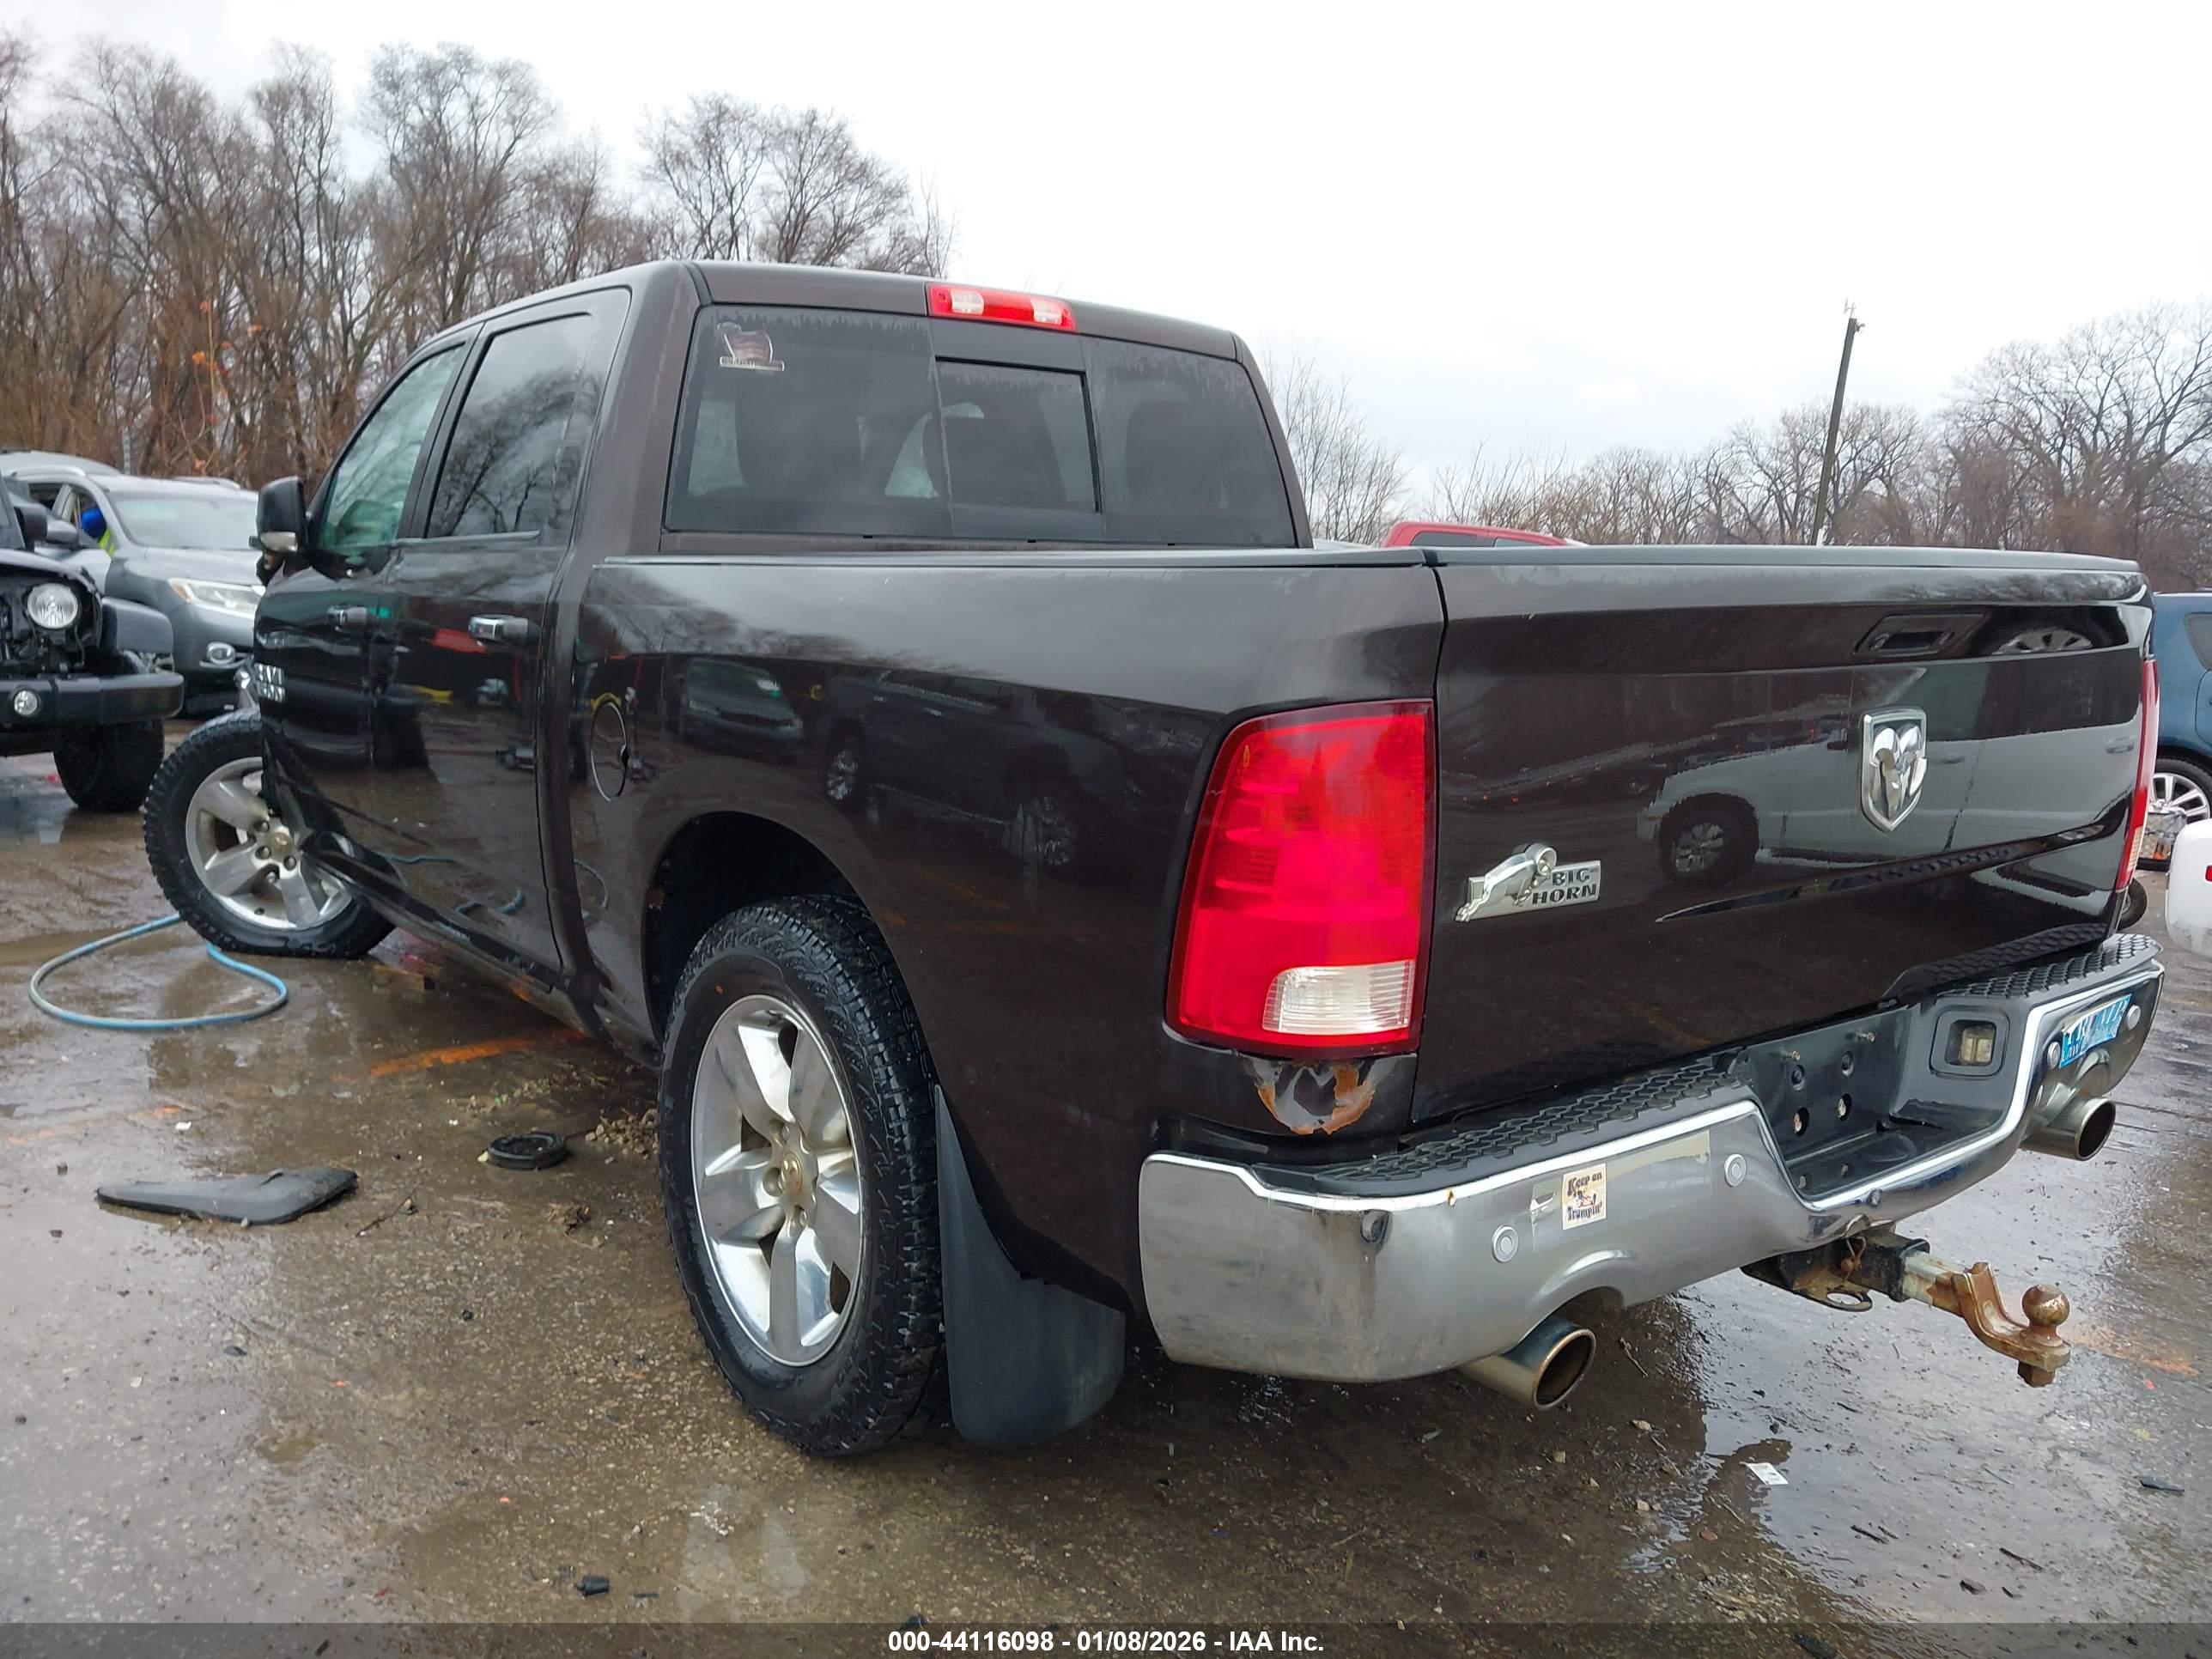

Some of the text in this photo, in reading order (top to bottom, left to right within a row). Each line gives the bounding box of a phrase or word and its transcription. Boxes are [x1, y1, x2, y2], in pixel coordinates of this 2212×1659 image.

[1552, 868, 1591, 886] BIG
[1532, 884, 1597, 904] HORN
[1567, 1172, 1602, 1198] Keep on
